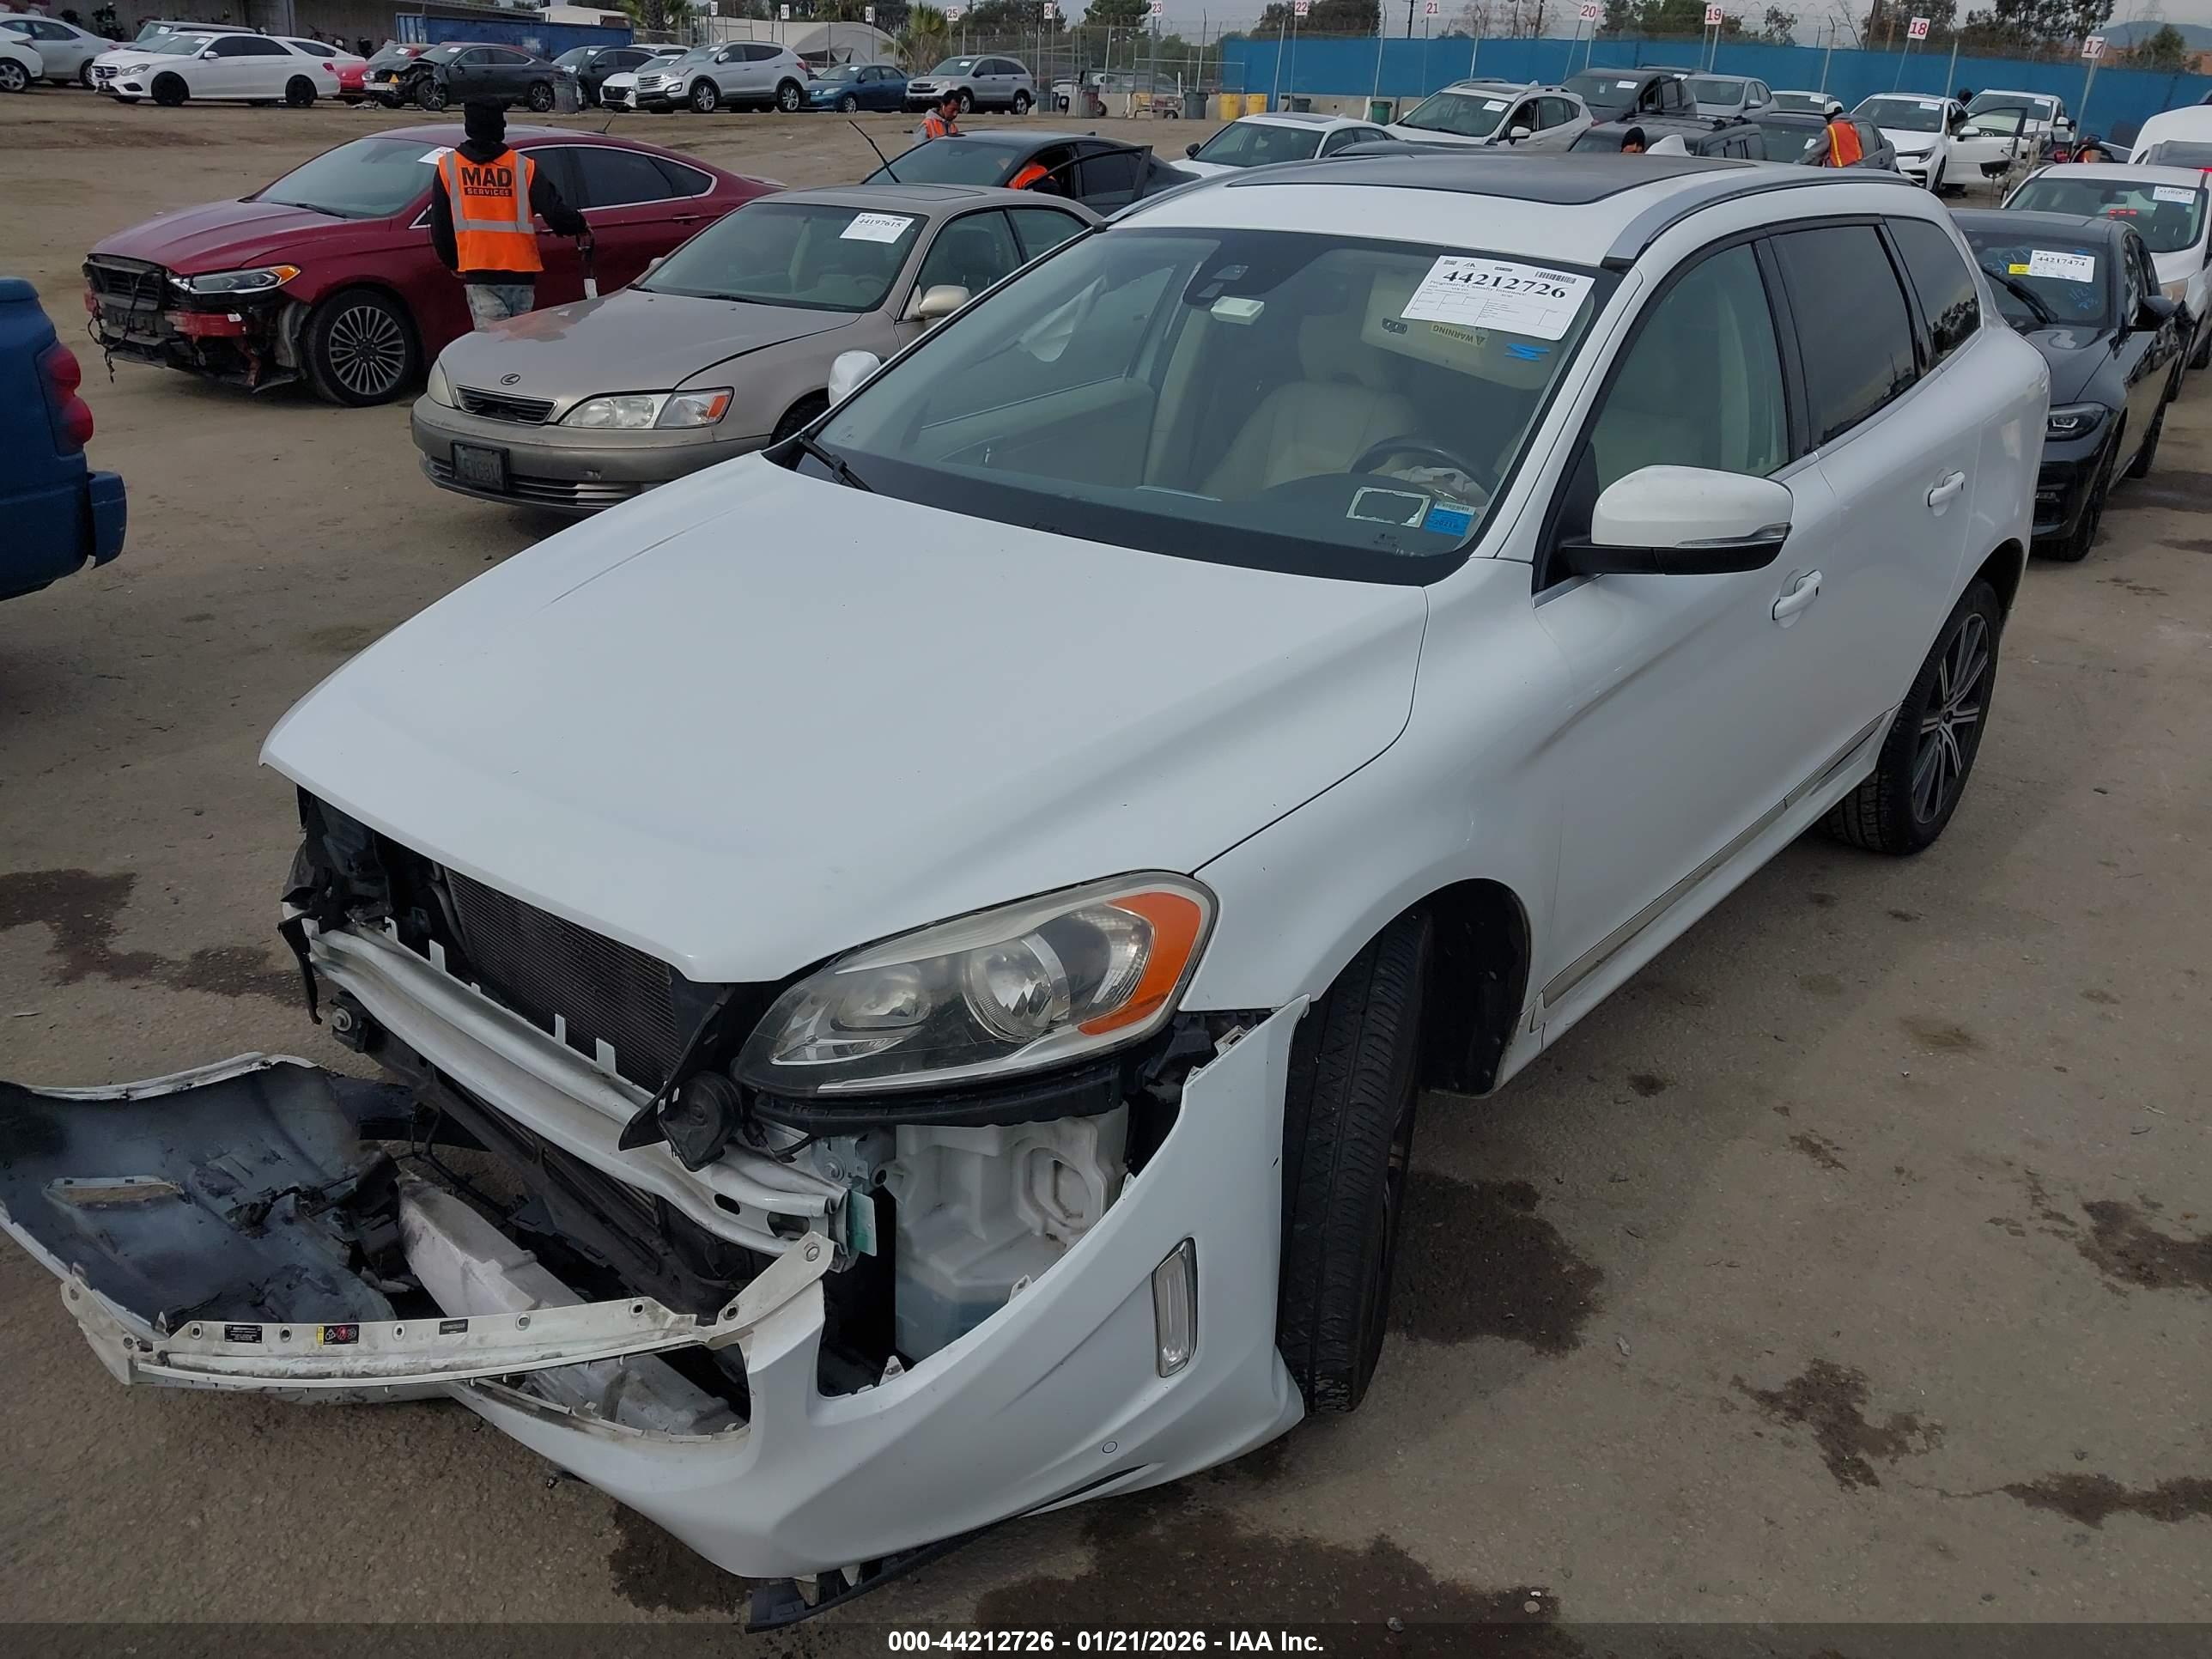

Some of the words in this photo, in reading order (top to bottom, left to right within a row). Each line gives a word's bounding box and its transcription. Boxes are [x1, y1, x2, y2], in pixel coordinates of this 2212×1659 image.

[781, 6, 789, 16] 27
[1152, 3, 1162, 14] 23
[1296, 2, 1308, 13] 22
[1427, 3, 1437, 14] 21
[1580, 5, 1596, 18] 20
[947, 9, 958, 19] 25
[1706, 8, 1722, 21] 19
[1910, 21, 1928, 35] 18
[2083, 40, 2104, 55] 17
[461, 167, 513, 186] MAD
[466, 188, 510, 197] SERVICES
[858, 219, 902, 228] 44197615
[2037, 257, 2085, 266] 44217474
[1442, 269, 1570, 299] 44212726
[1432, 325, 1474, 343] WARNING
